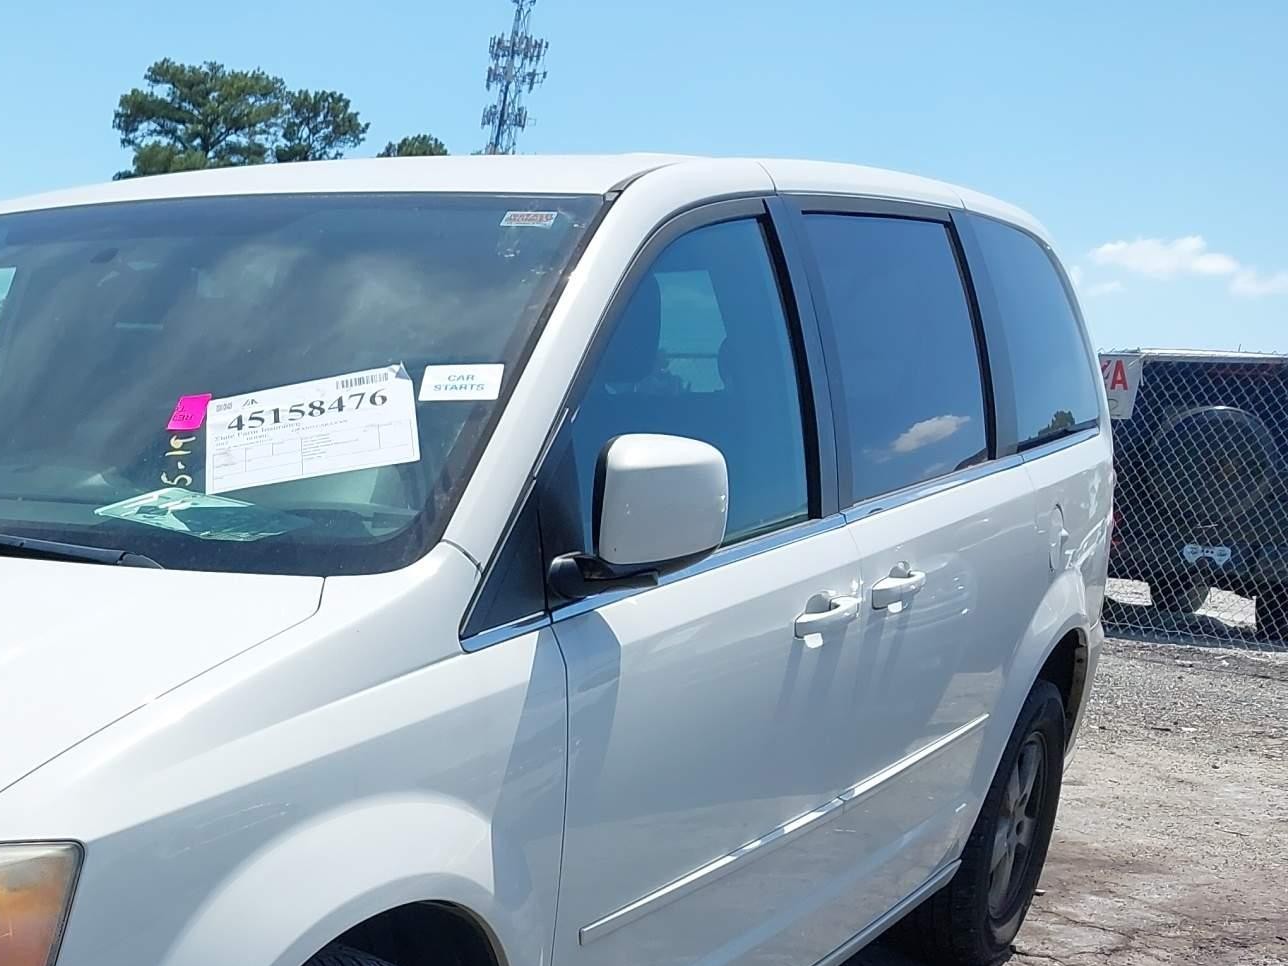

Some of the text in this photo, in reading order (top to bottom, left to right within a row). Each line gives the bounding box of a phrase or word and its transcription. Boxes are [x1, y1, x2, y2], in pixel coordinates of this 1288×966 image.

[433, 383, 486, 392] STARTS
[448, 374, 476, 382] CAR
[228, 388, 388, 431] 45158476
[161, 435, 196, 486] 5-19
